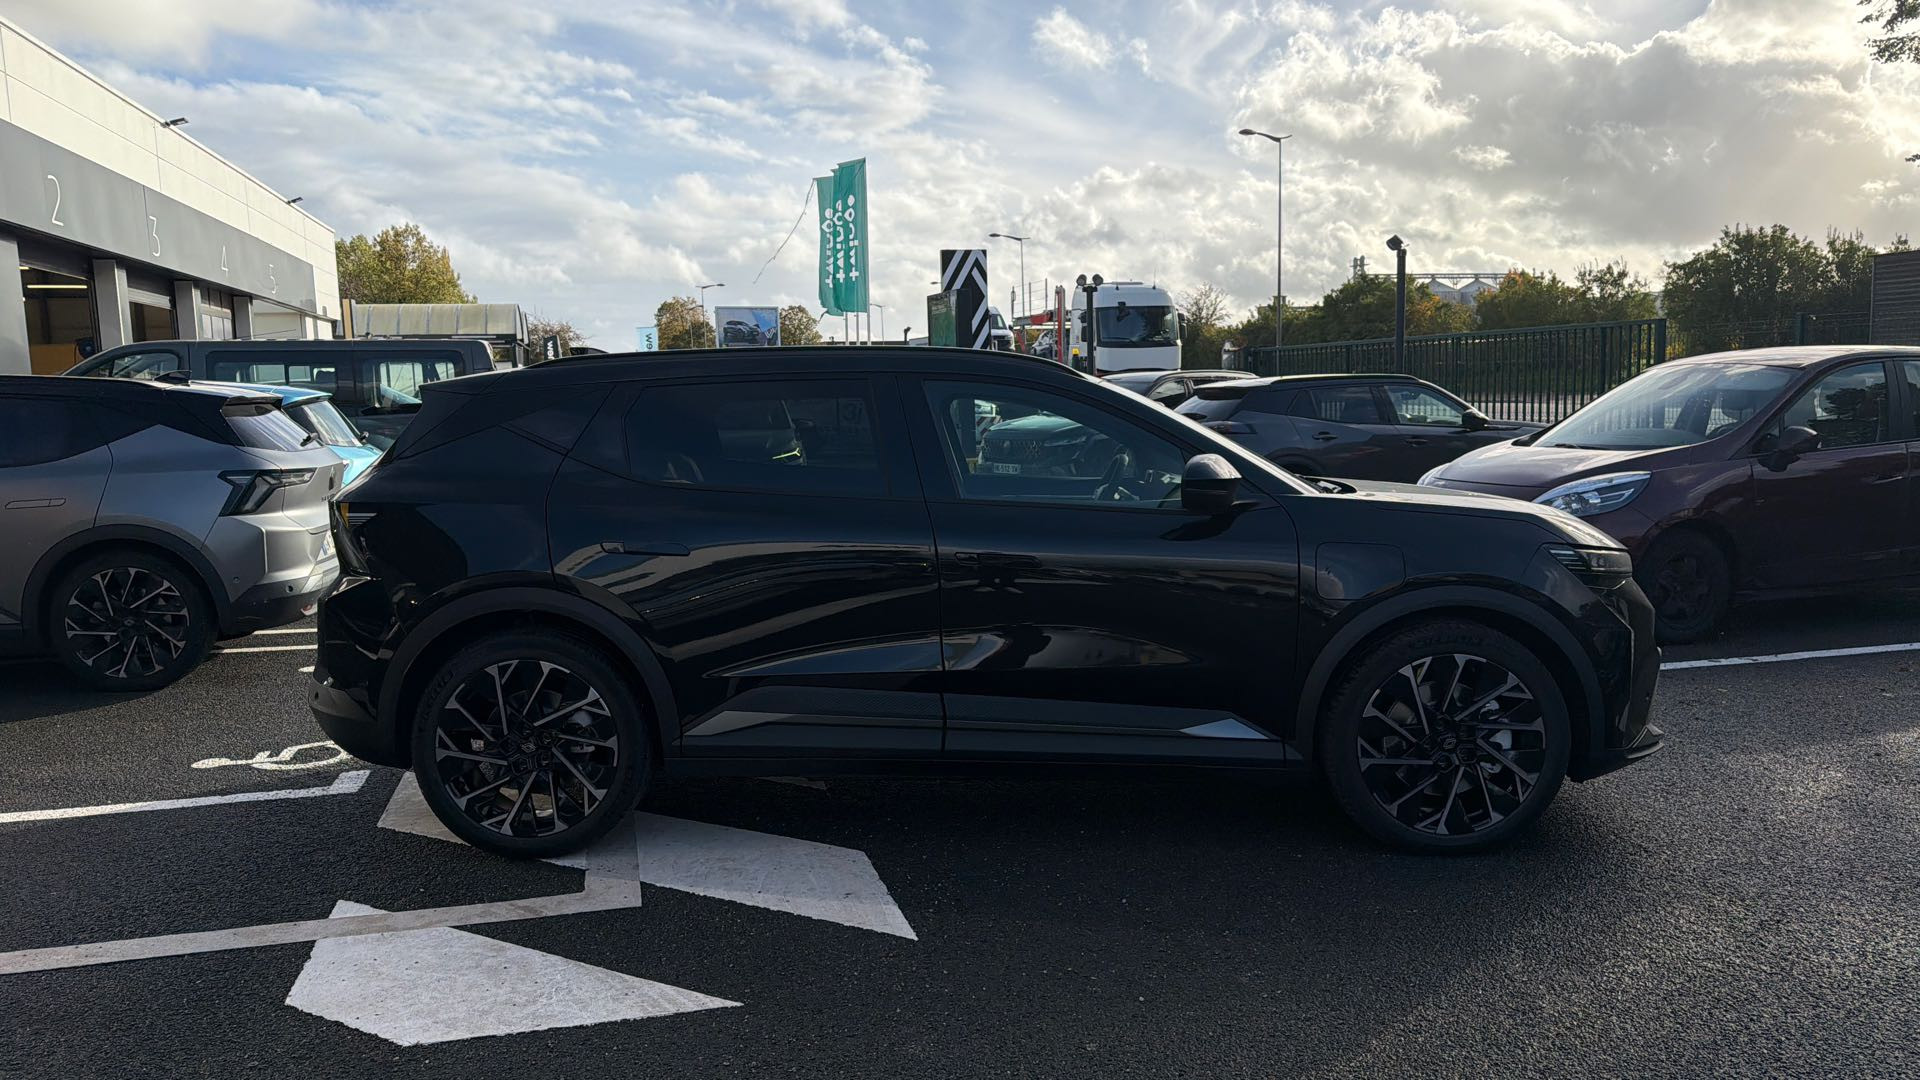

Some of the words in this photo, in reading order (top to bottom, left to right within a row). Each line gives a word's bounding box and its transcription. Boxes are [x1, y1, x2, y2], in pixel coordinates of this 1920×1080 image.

[47, 174, 64, 227] 2
[149, 215, 161, 257] 3
[220, 245, 229, 276] 4
[268, 263, 277, 294] 5
